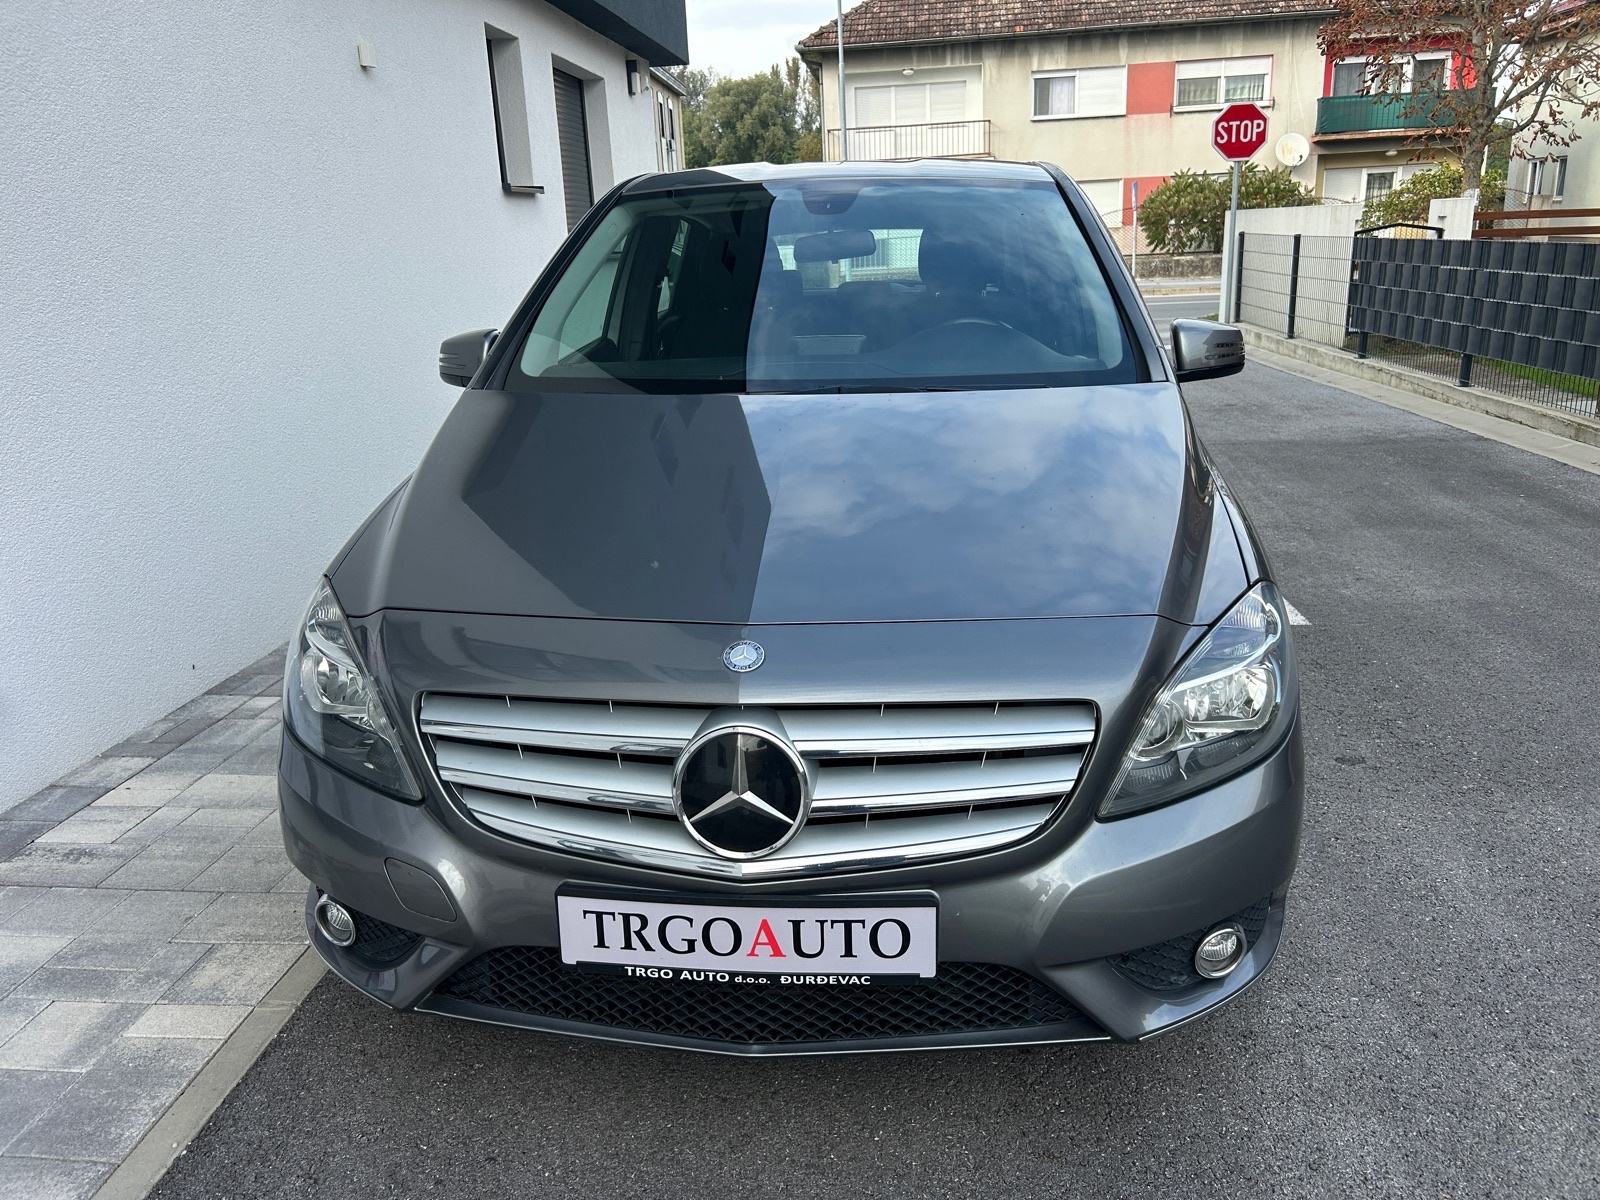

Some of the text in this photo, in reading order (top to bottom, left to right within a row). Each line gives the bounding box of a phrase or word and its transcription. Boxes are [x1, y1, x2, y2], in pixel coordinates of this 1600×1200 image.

[1216, 119, 1265, 144] STOP
[582, 909, 912, 959] TRGOAUTO
[624, 966, 871, 985] TRGO AUTO d.o.o. ĐURĐEVAC
